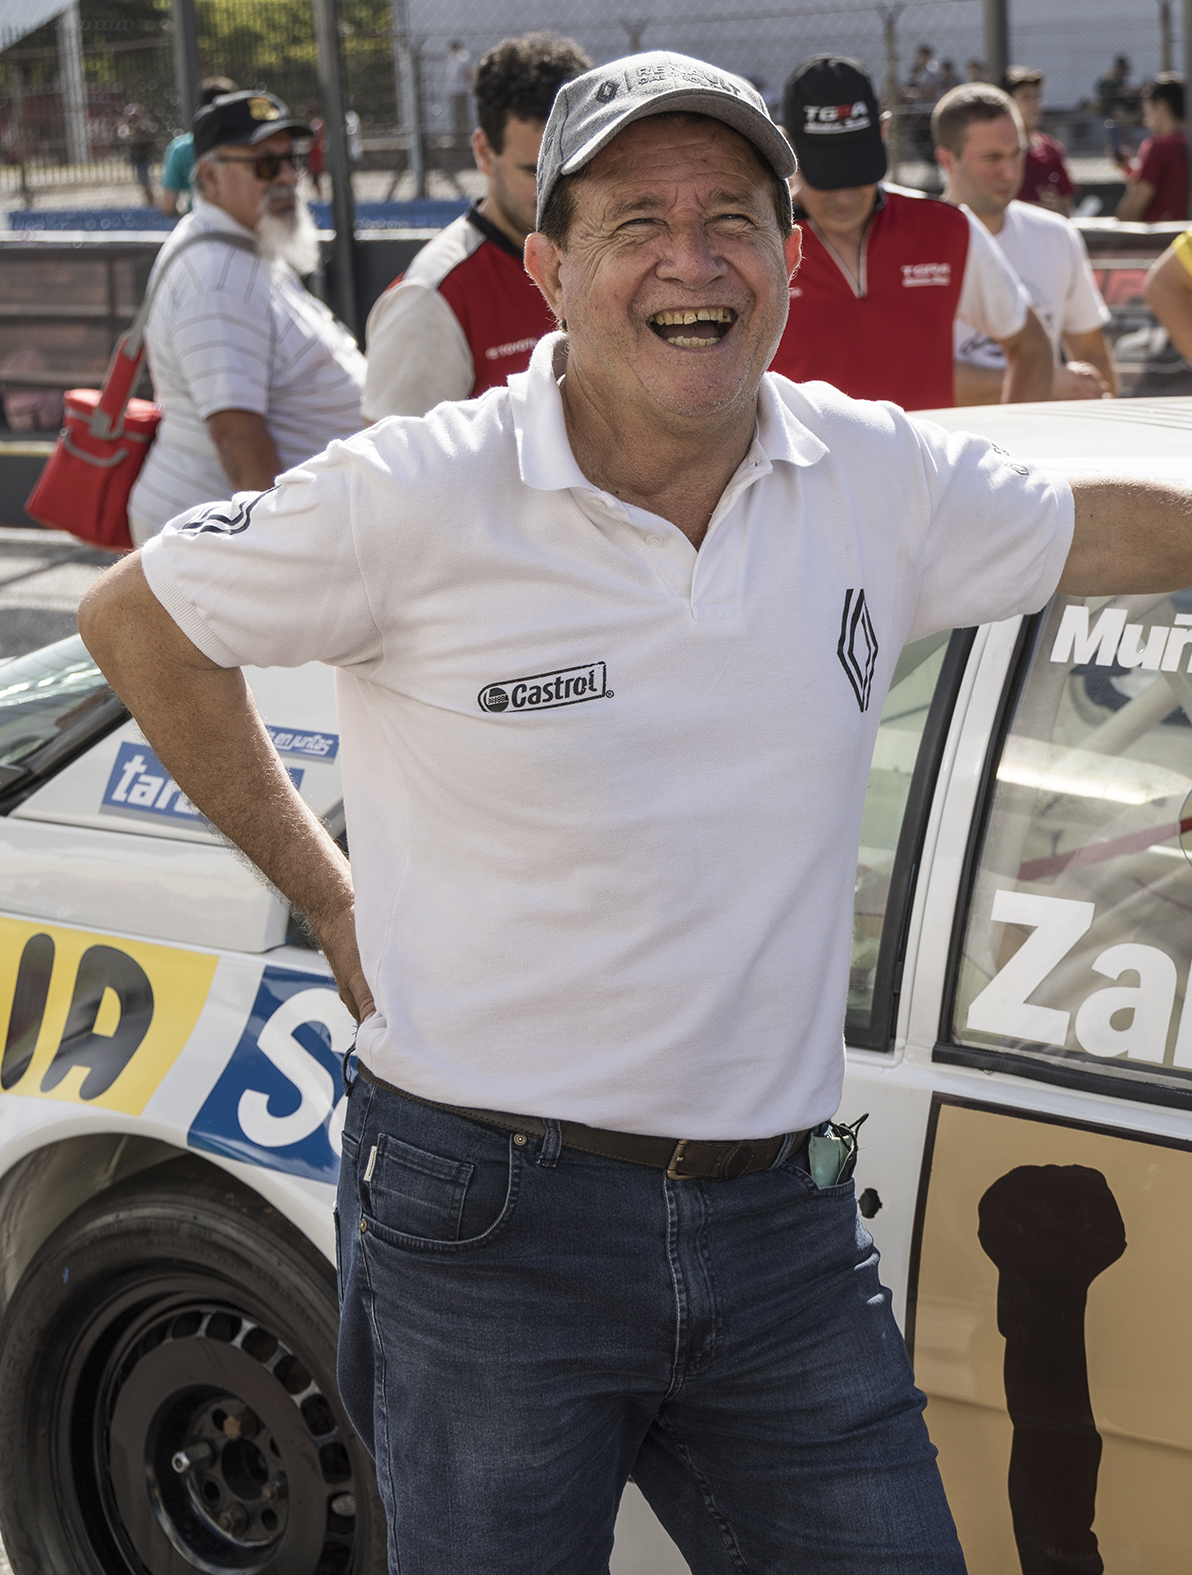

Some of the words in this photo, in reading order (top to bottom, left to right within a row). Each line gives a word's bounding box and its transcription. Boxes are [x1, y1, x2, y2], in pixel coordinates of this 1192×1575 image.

[511, 669, 597, 708] Castrol
[286, 734, 334, 755] juntas
[111, 755, 205, 815] tar
